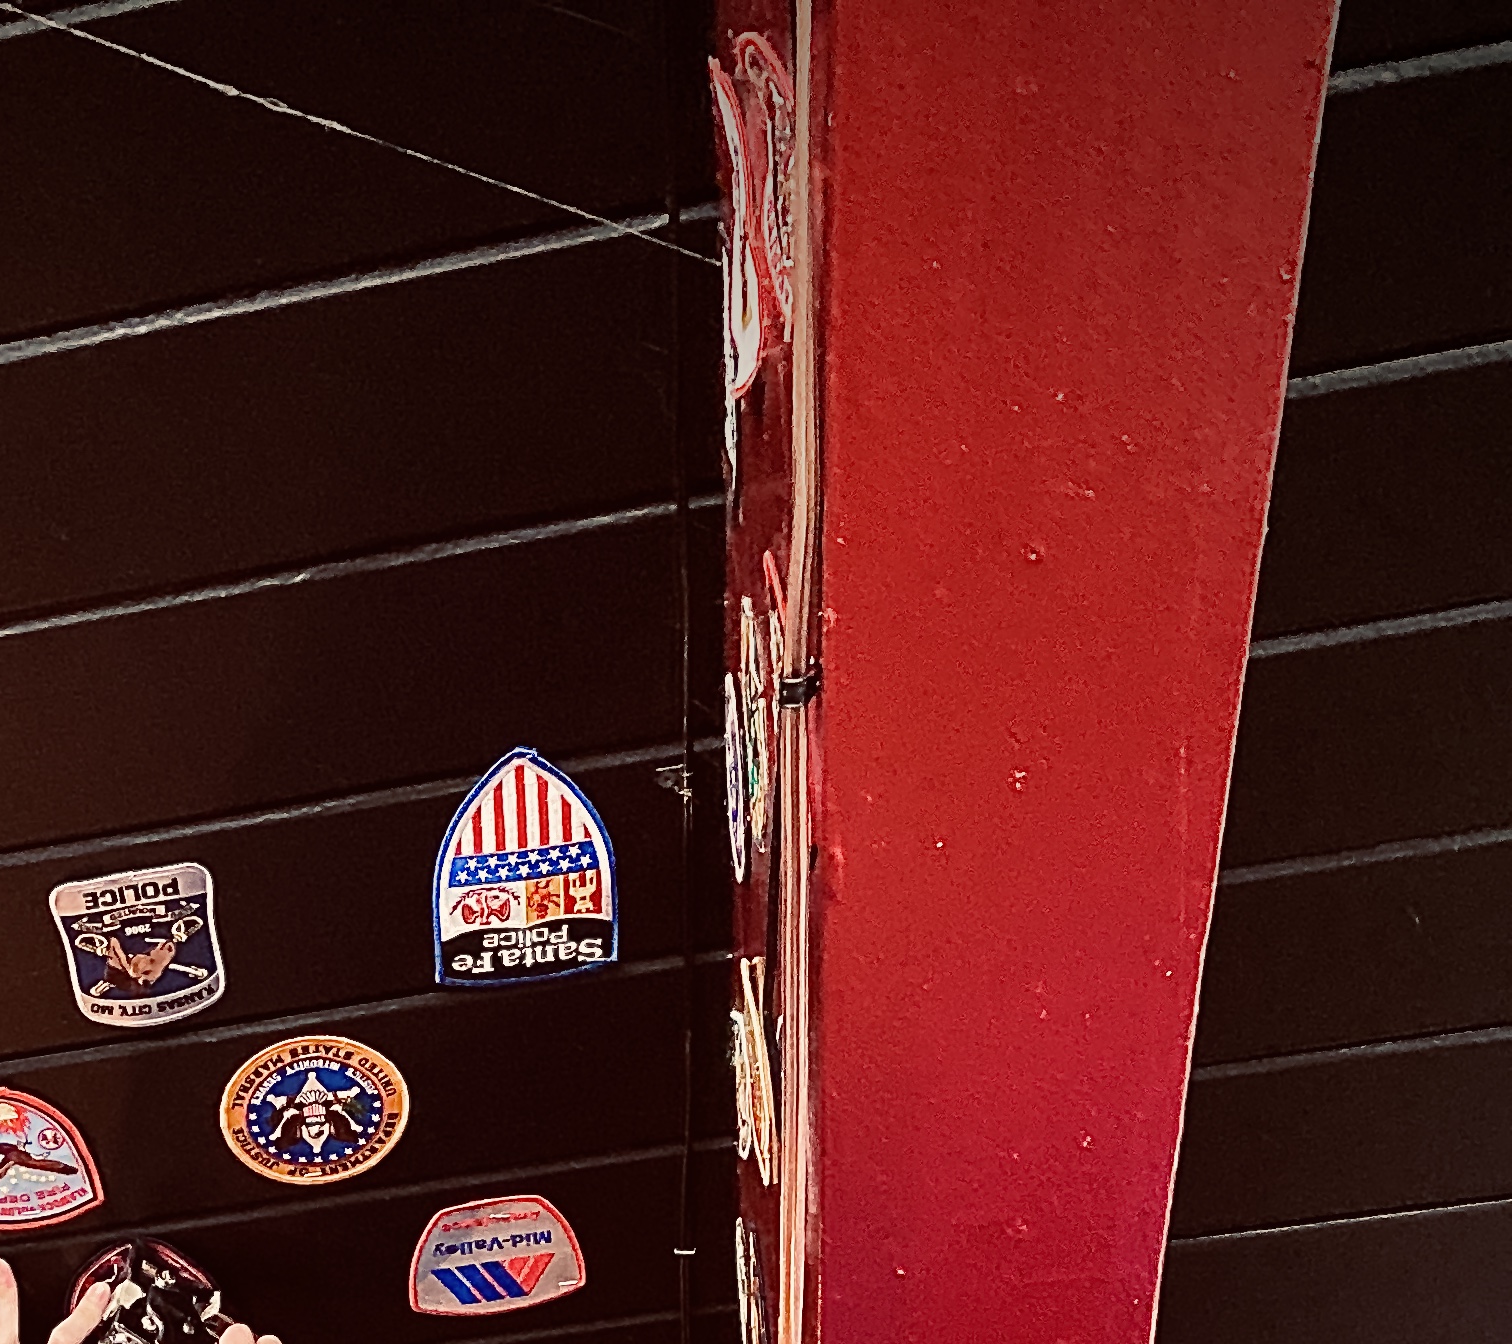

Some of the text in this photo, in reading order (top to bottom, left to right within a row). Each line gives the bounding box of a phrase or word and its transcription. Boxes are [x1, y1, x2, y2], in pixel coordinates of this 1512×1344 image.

[82, 878, 180, 911] POLICE
[482, 924, 569, 948] Police
[451, 938, 603, 974] Santa Fe
[90, 1003, 114, 1016] MO
[157, 984, 216, 1012] KANSAS
[231, 1045, 396, 1110] UNITED STATES MARSHAL
[232, 1127, 279, 1169] JUSTICE
[308, 1112, 399, 1176] DEPARTMENT
[432, 1230, 552, 1258] Mid-Valley
